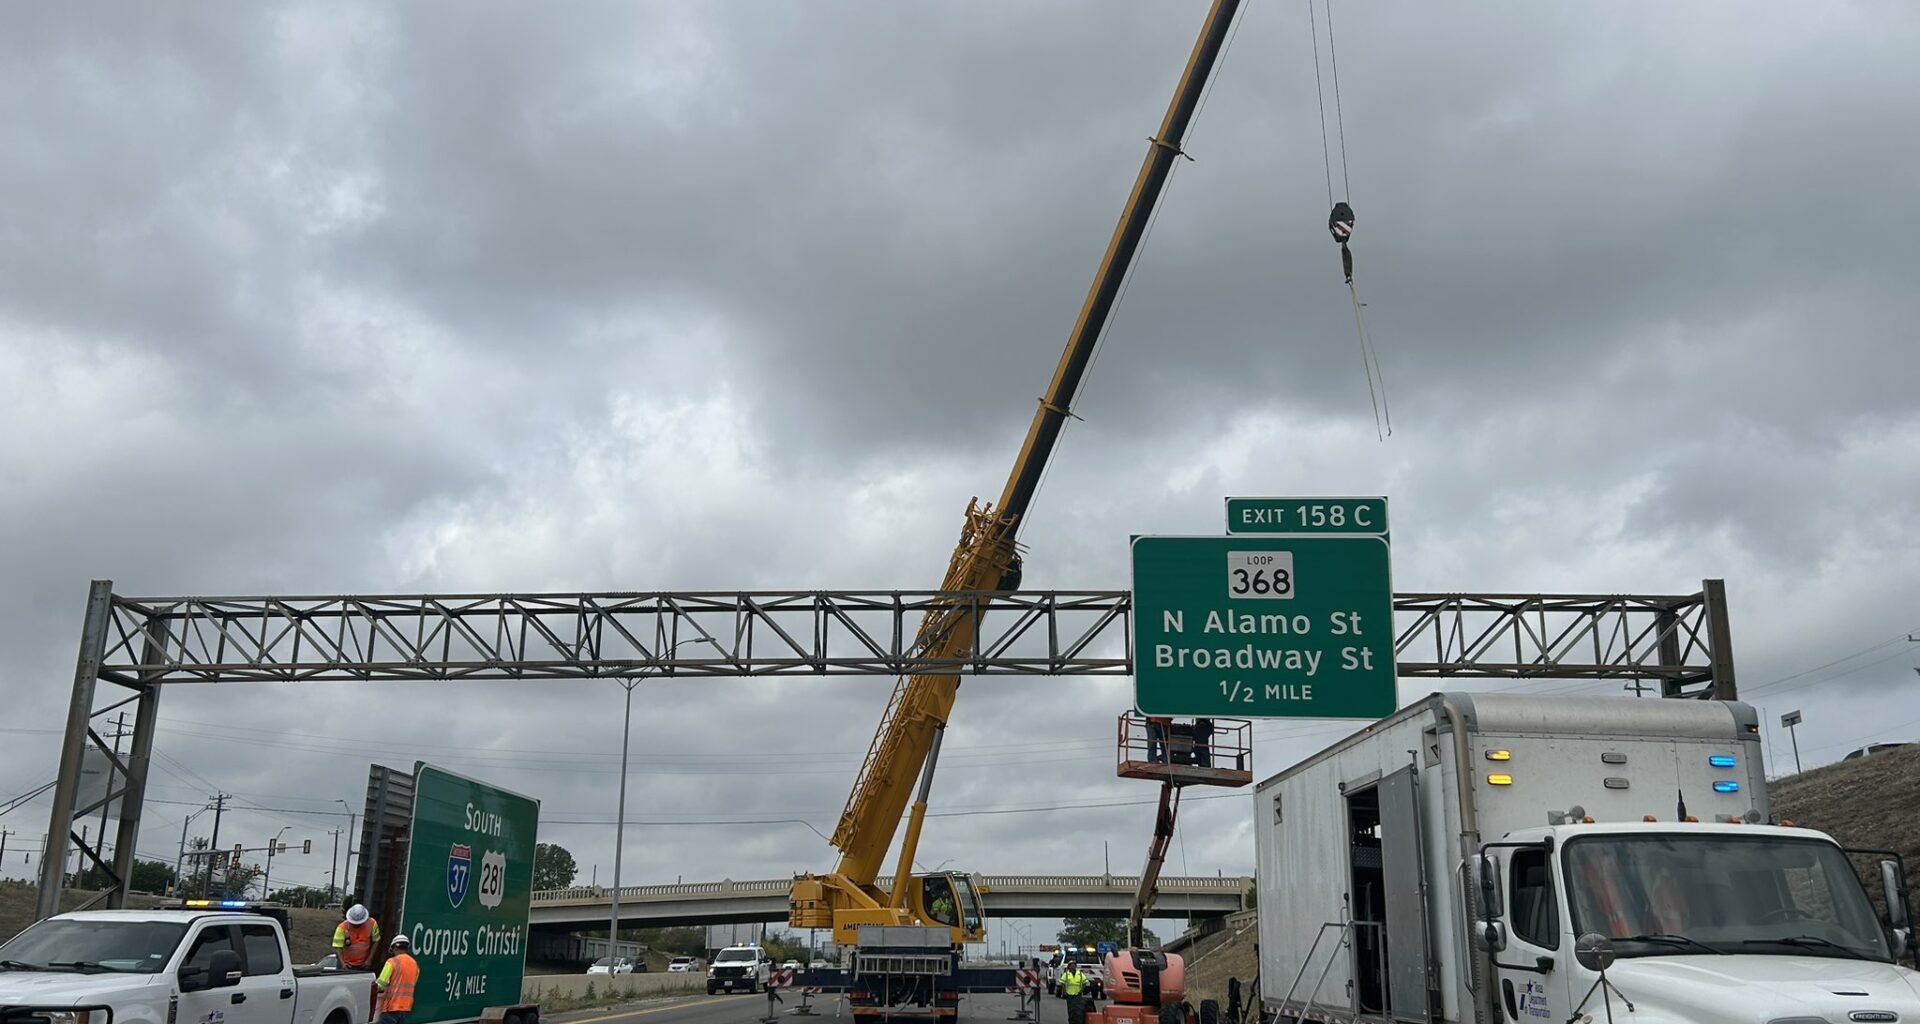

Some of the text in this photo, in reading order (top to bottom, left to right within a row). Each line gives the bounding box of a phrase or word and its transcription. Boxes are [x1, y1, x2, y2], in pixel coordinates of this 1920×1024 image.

[1242, 504, 1372, 527] EXIT 158 C
[1246, 556, 1274, 565] LOOP
[1232, 568, 1291, 595] 368
[1163, 609, 1363, 635] N Alamo St
[1155, 644, 1374, 676] Broadway St
[1219, 680, 1313, 703] 1/2 MILE
[464, 803, 501, 836] SOUTH
[451, 864, 467, 893] 37
[481, 863, 503, 896] 281
[412, 922, 520, 964] Corpus Christi
[445, 971, 487, 1001] 3/4 MILE
